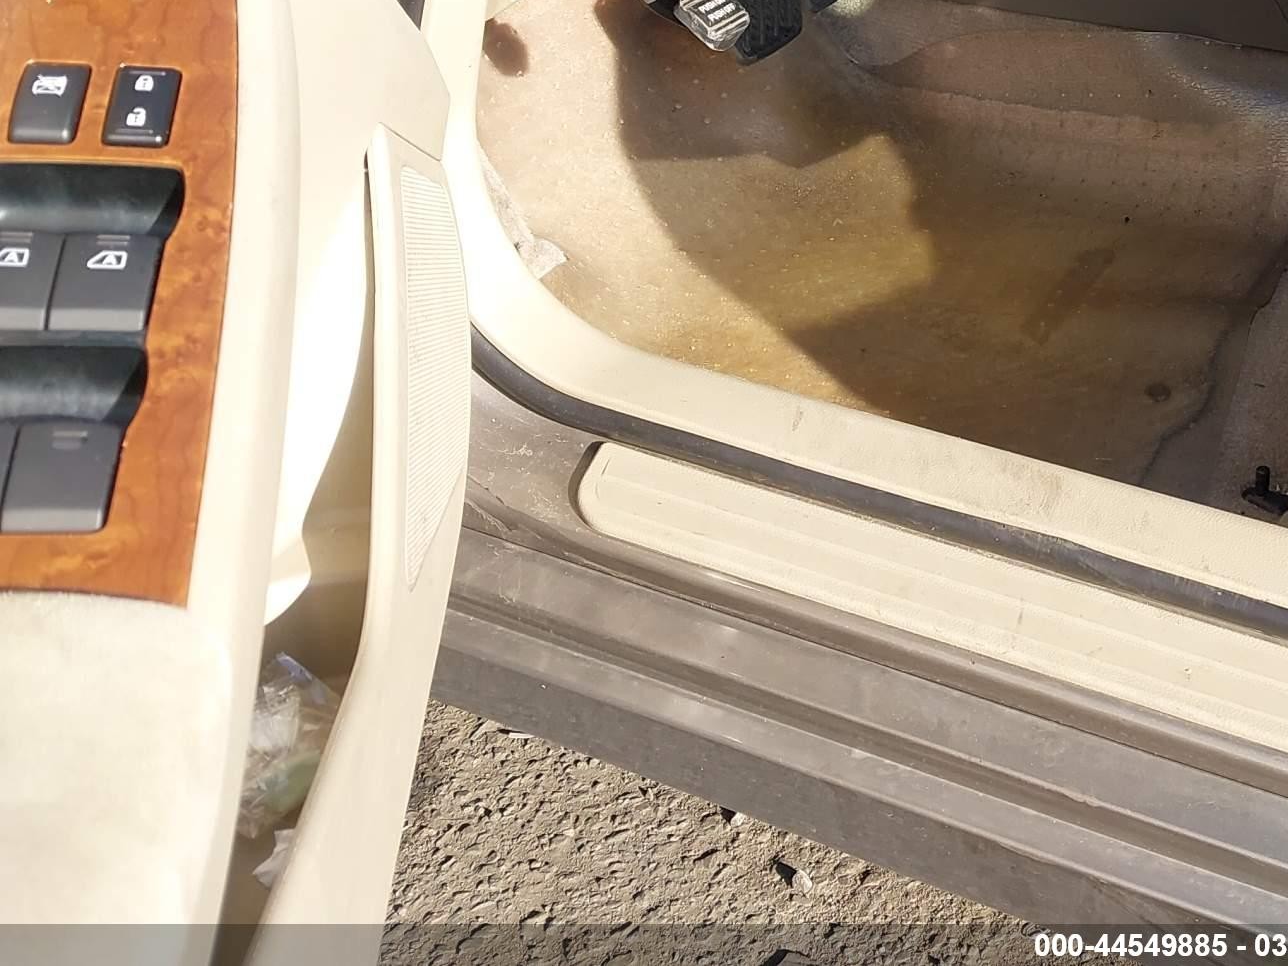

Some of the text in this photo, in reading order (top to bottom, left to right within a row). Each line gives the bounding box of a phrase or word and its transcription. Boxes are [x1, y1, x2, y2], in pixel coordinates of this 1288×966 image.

[698, 0, 716, 14] PUSH
[708, 2, 736, 23] PUSH OFF
